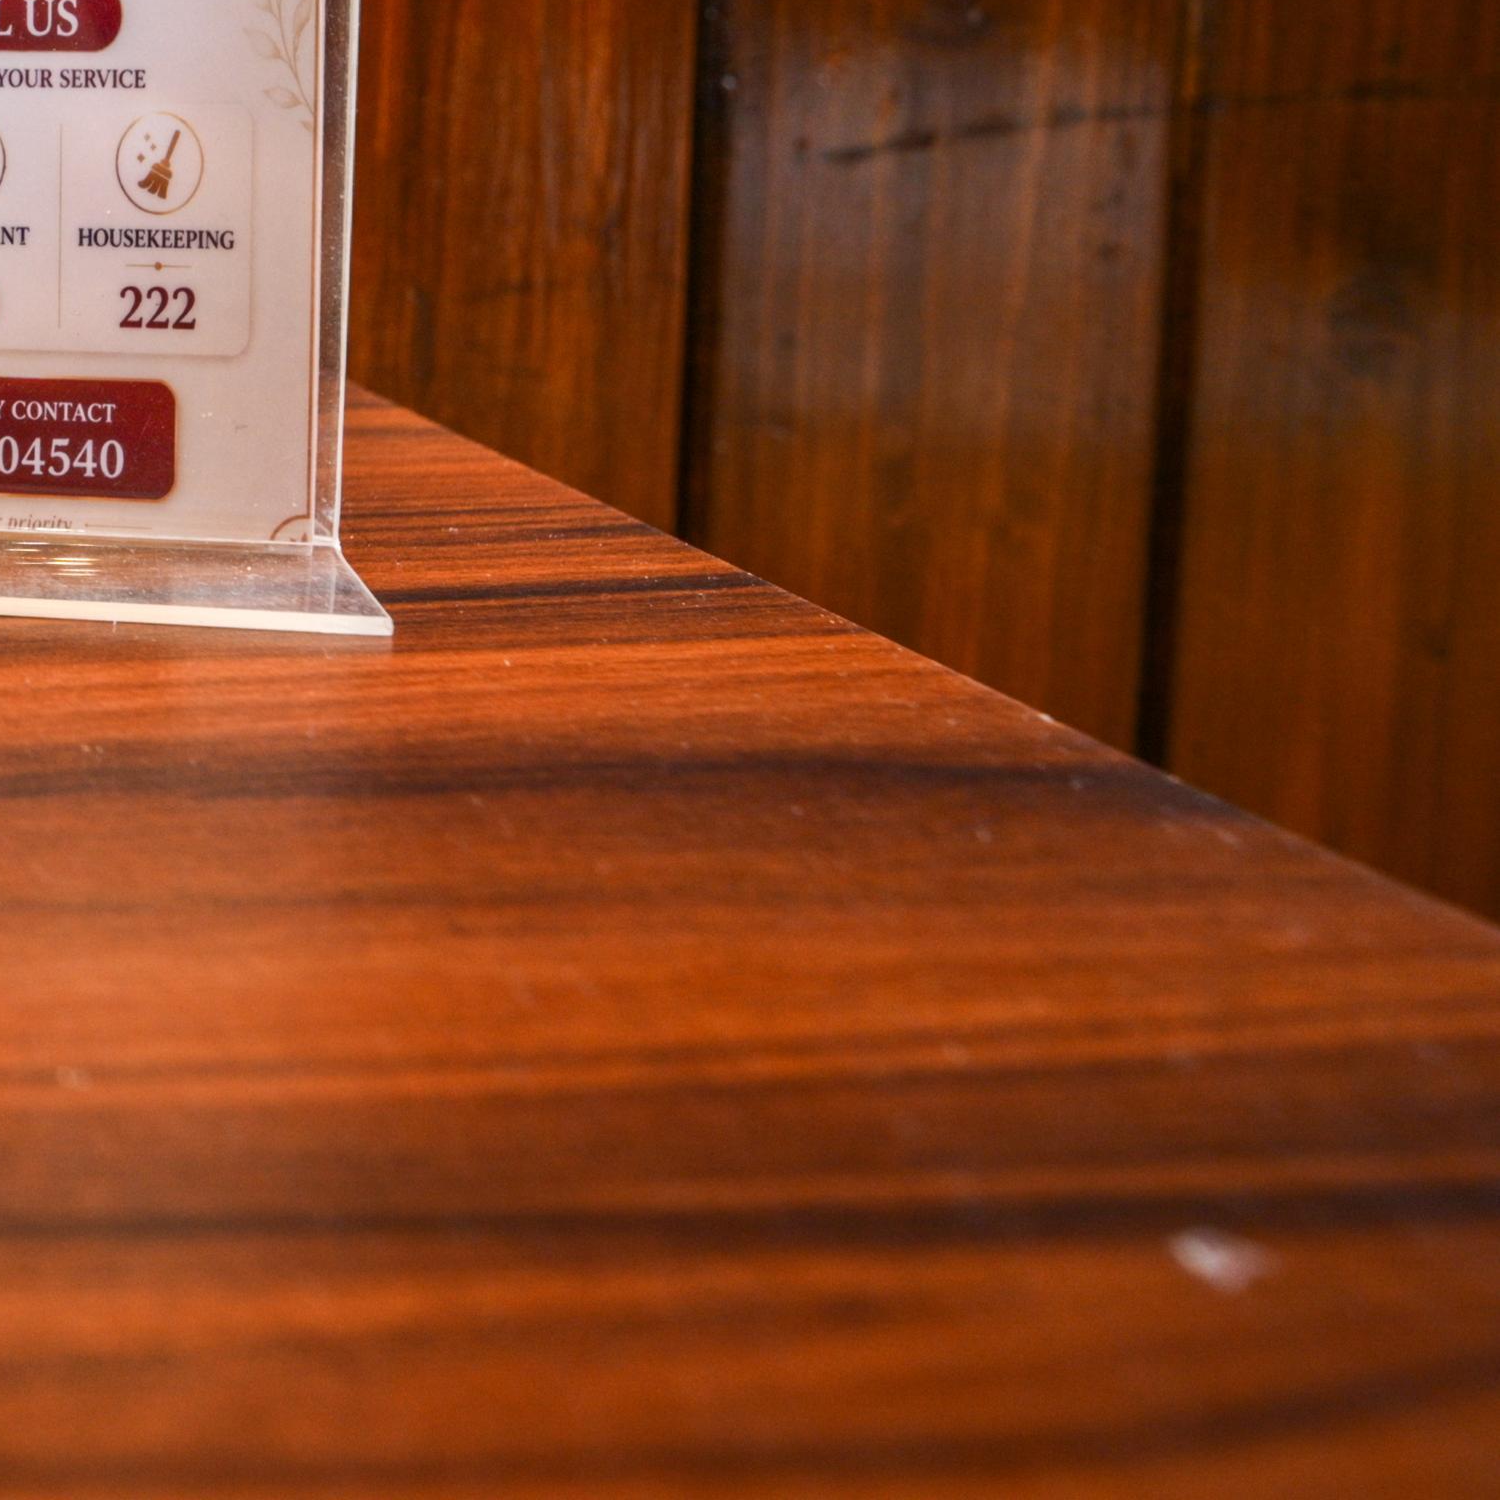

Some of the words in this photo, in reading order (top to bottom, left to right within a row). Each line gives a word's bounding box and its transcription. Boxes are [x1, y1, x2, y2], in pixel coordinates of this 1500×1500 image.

[60, 69, 146, 89] SERVICE
[78, 228, 235, 250] HOUSEKEEPING
[119, 286, 197, 330] 222
[11, 400, 116, 423] CONTACT
